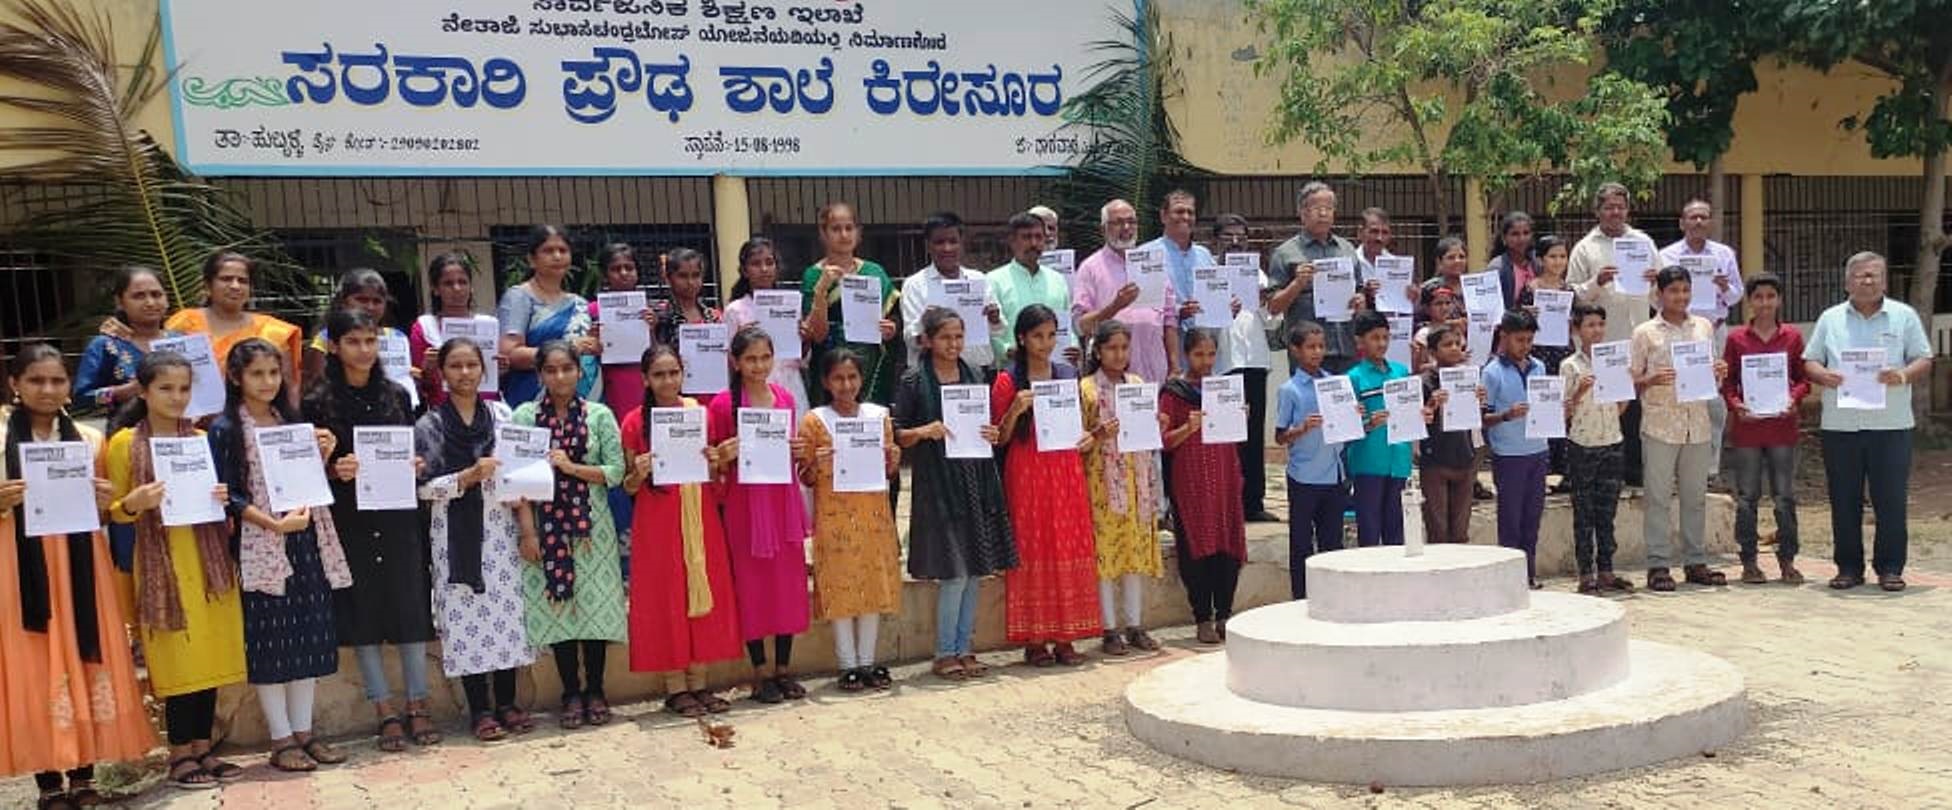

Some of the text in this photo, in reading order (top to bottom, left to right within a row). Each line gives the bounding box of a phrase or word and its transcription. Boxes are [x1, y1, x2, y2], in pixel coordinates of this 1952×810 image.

[441, 13, 520, 34] ನೇತಾಜಿ
[699, 1, 776, 24] ಶಿಕ್ಷಣ
[788, 3, 865, 25] ಇಲಾಖೆ
[281, 42, 1062, 124] ಸರಕಾರಿ ಪ್ರೌಢ ಶಾಲೆ ಕಿರೇಸೂರ
